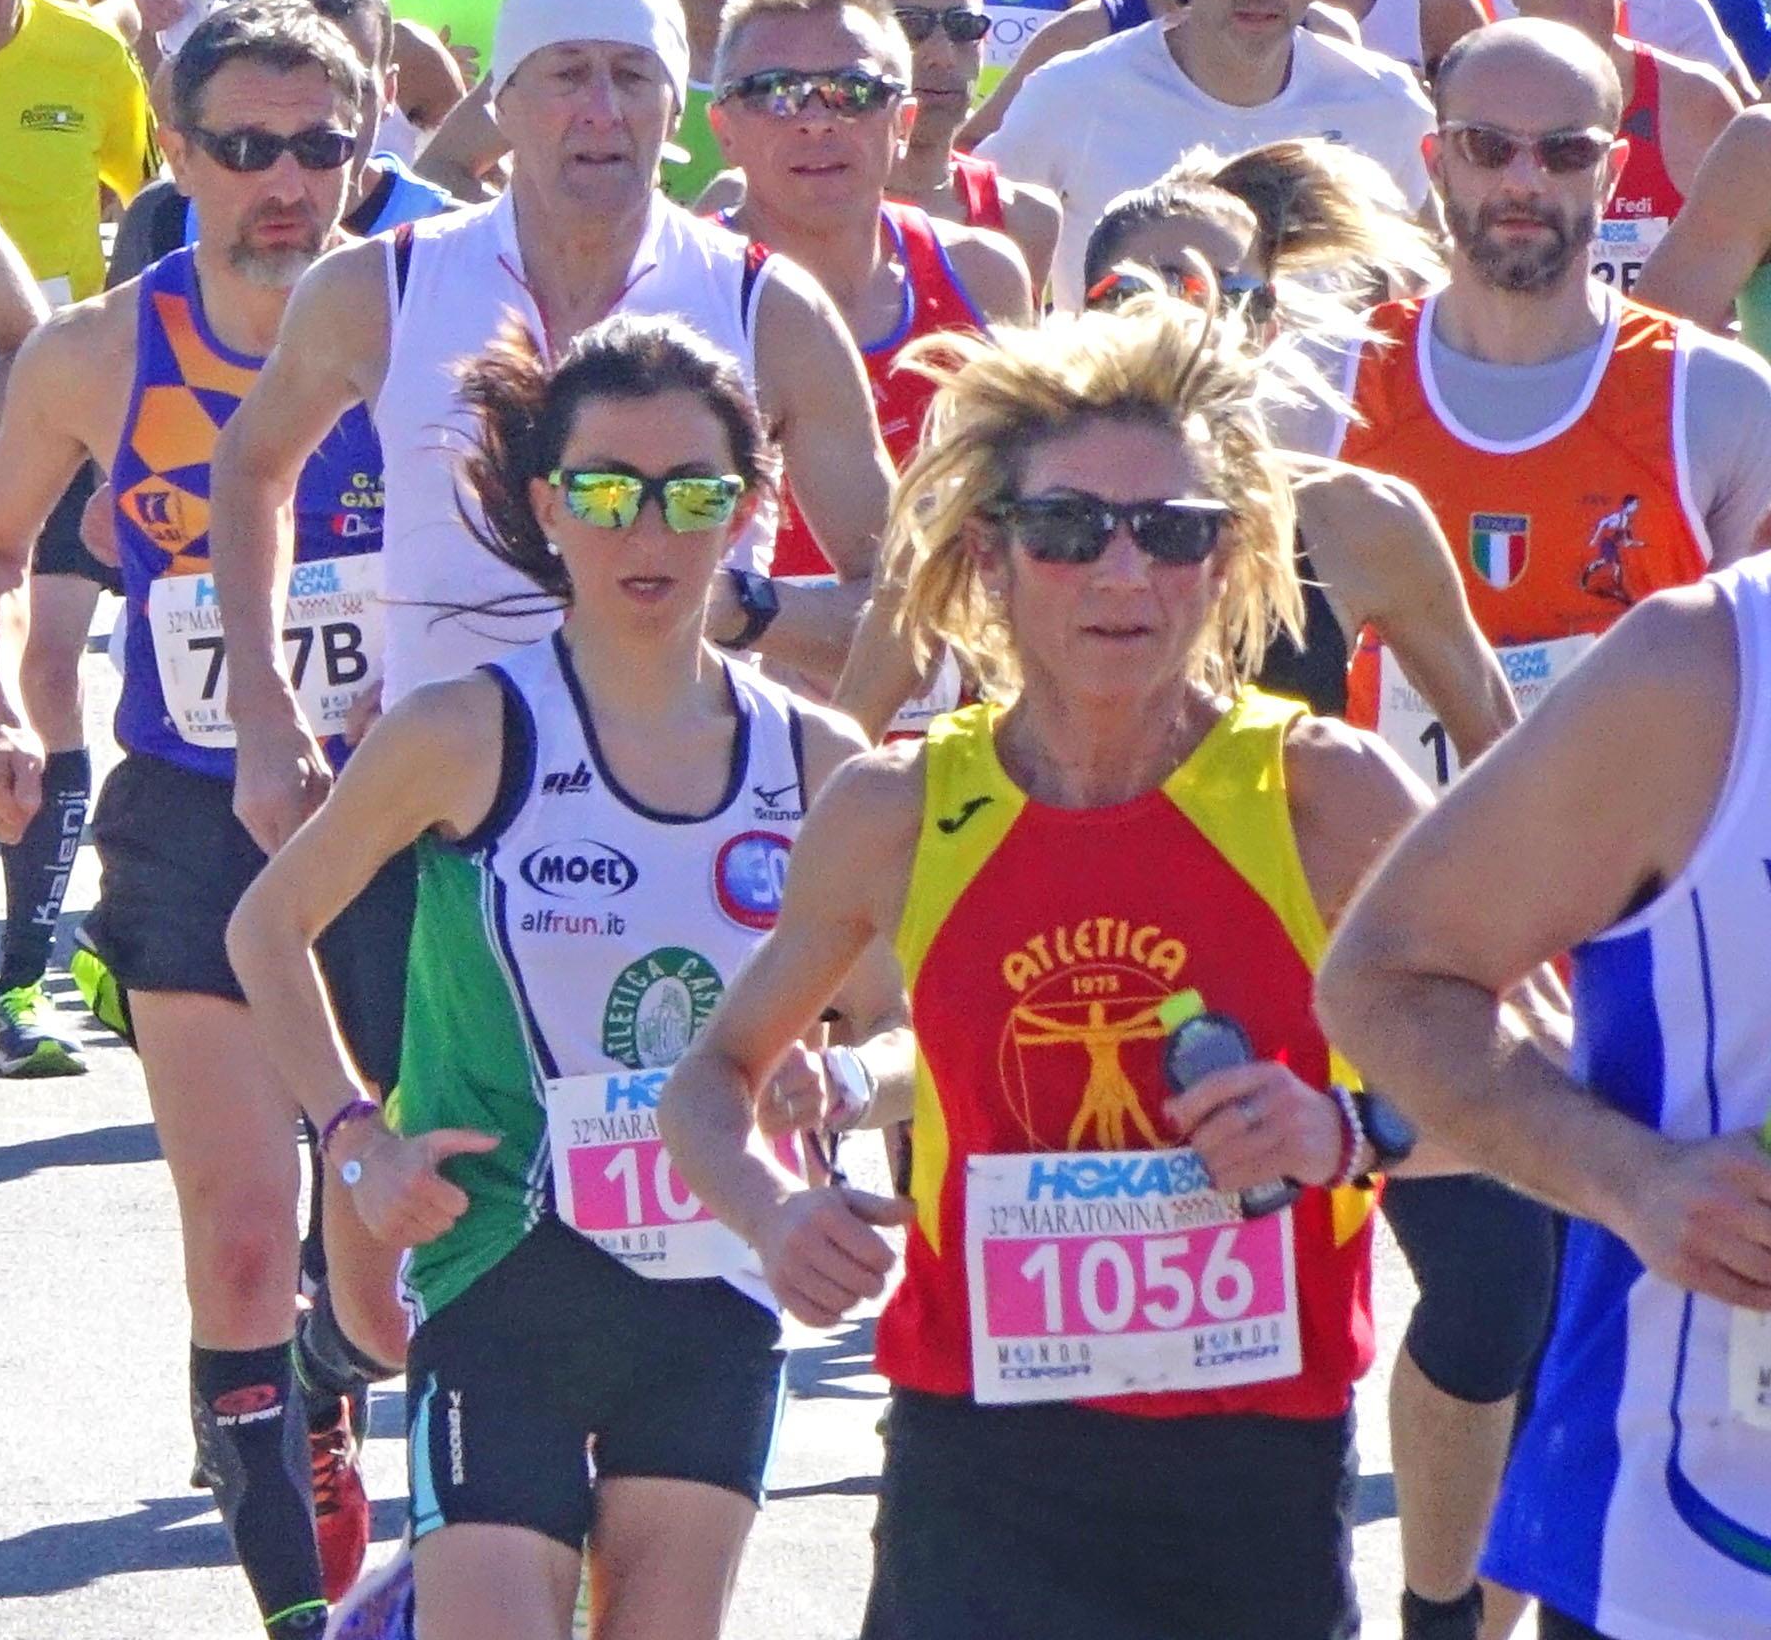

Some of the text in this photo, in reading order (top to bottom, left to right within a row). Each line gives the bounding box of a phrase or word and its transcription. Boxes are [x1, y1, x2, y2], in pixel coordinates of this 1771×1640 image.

[1615, 198, 1652, 214] Fedi
[188, 622, 368, 702] 77B
[33, 790, 87, 926] kalenji
[521, 909, 627, 936] alfrun.it
[1003, 917, 1189, 992] ATLETICA
[604, 1147, 703, 1226] 10
[1027, 1159, 1170, 1201] HOKA
[1020, 1227, 1256, 1335] 1056
[999, 1363, 1092, 1381] CORSA
[1194, 1343, 1281, 1370] CORSA
